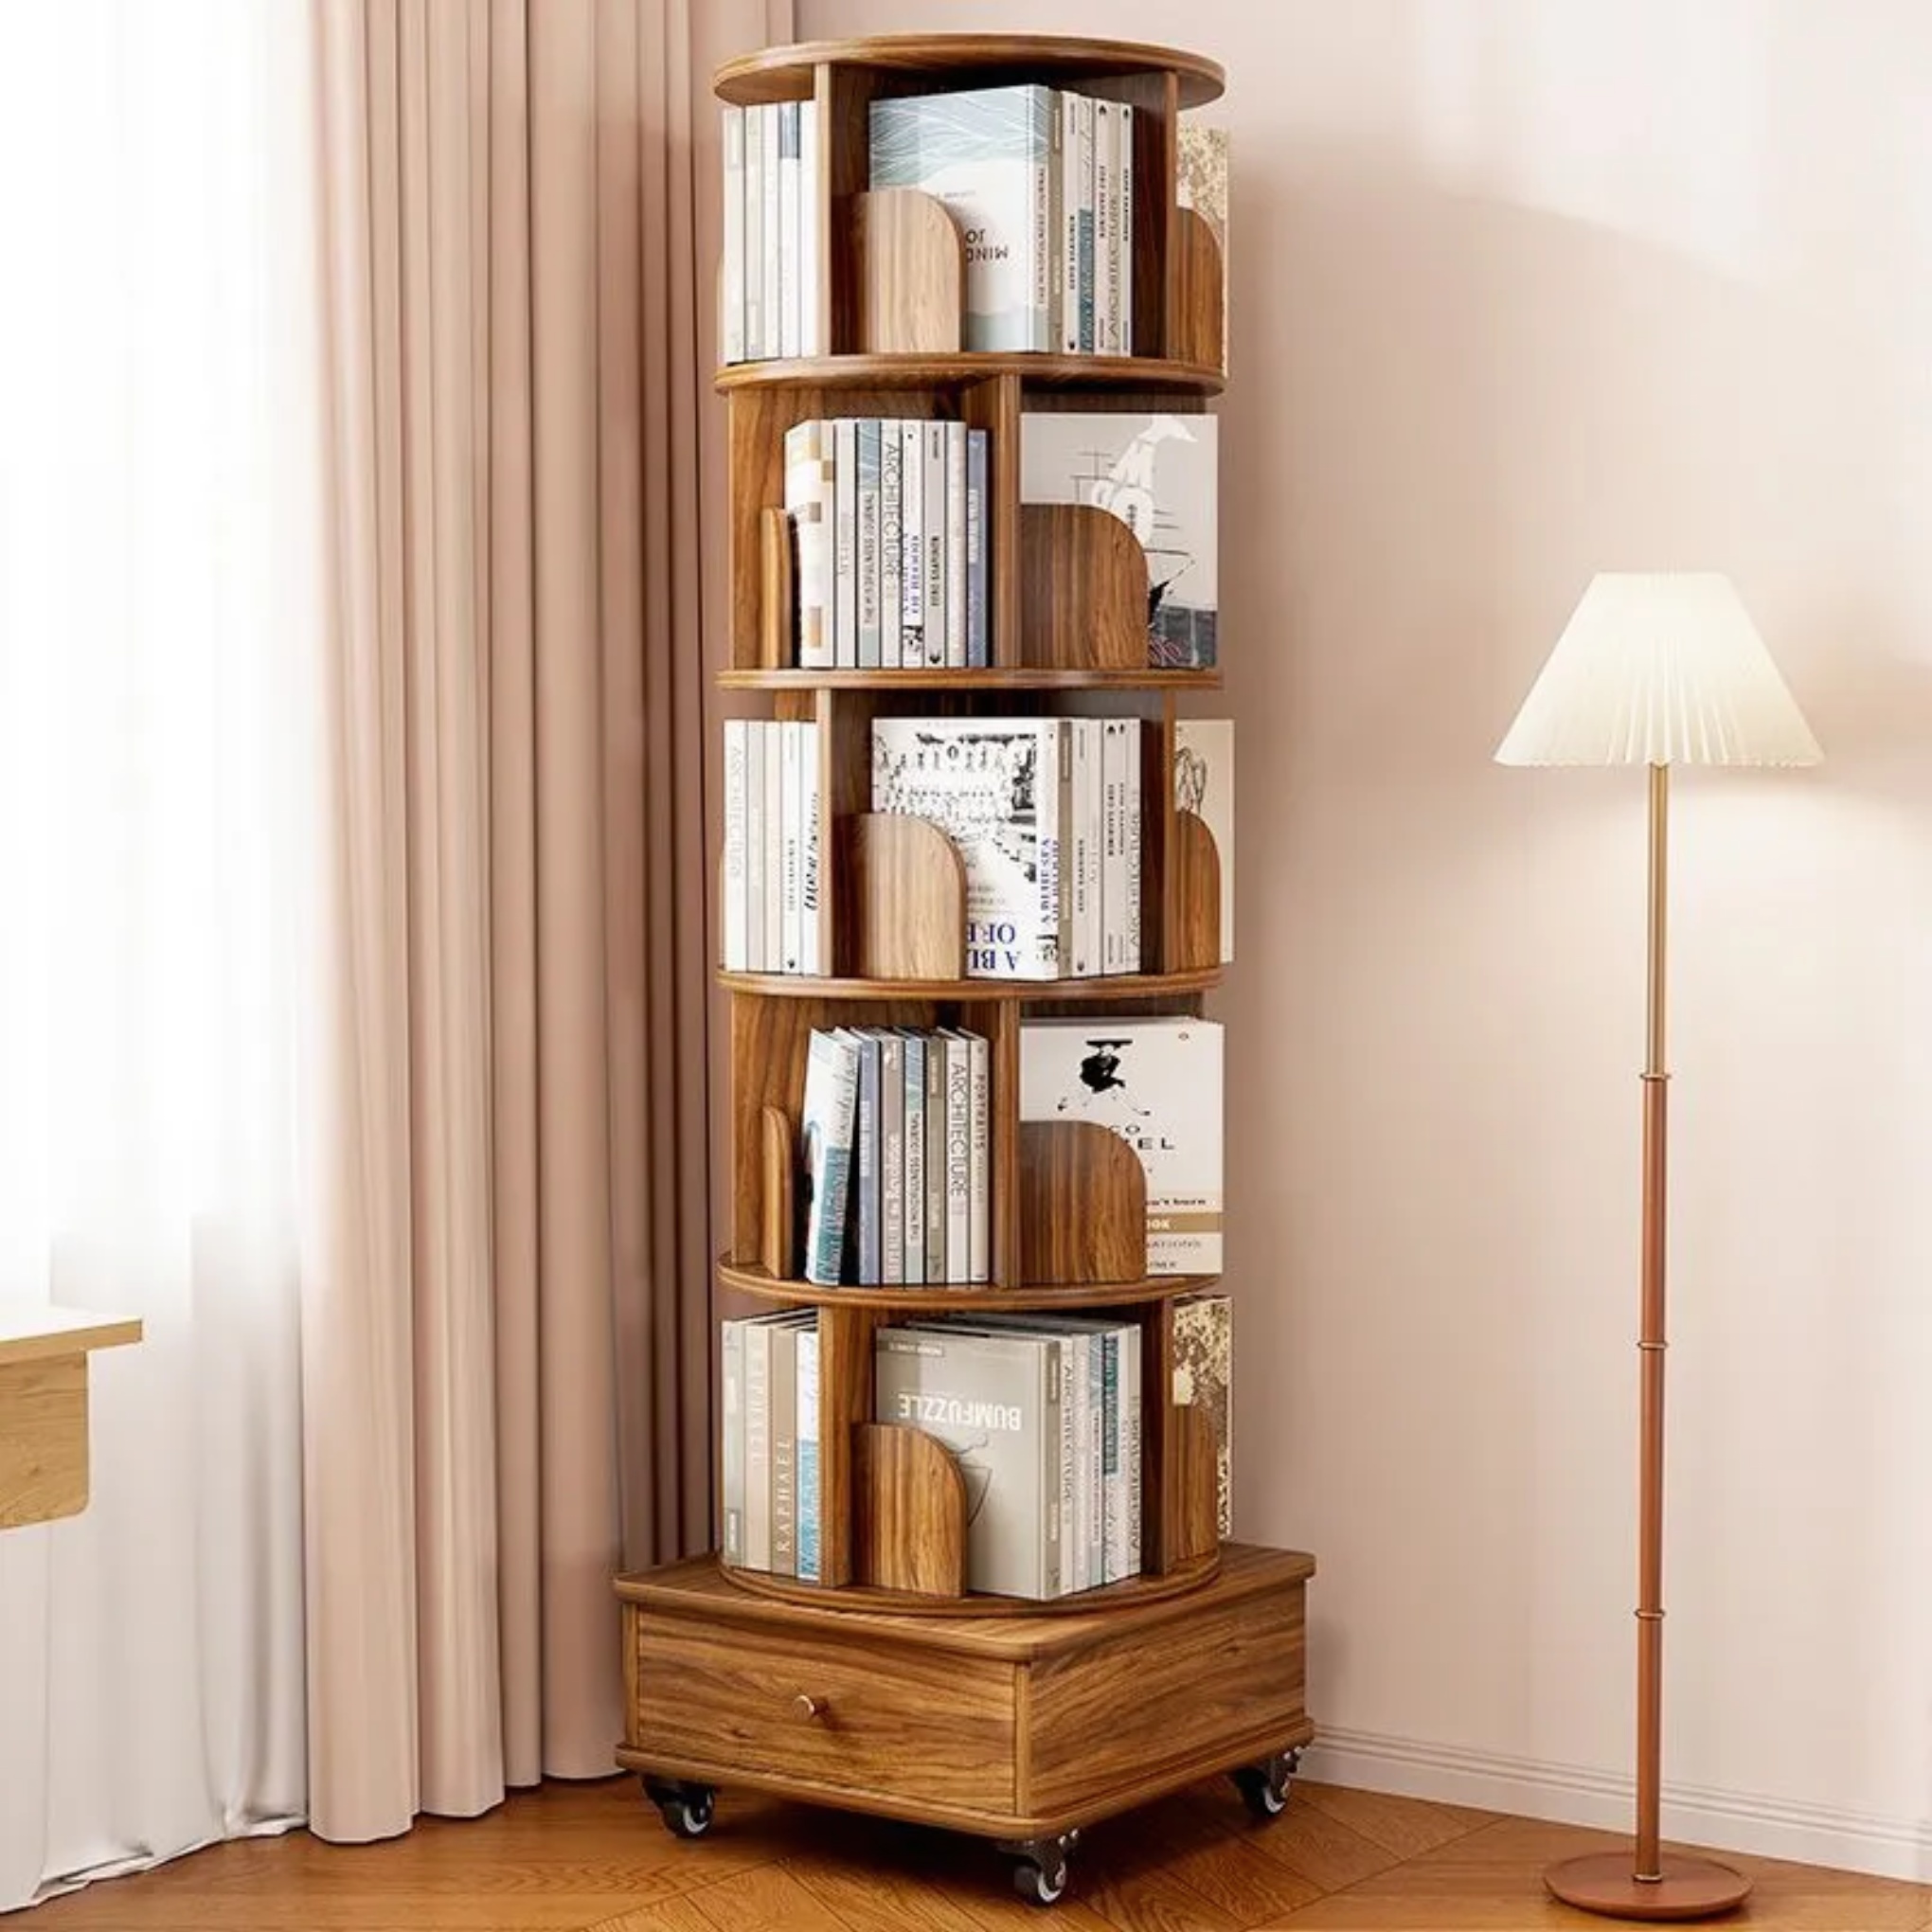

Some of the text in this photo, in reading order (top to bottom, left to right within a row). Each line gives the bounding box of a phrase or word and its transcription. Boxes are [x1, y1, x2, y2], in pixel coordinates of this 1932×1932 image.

[883, 442, 901, 577] ARCHITECTURE
[1004, 950, 1021, 971] A
[950, 1062, 967, 1196] ARCHITECTURE
[898, 1392, 1023, 1432] BUMFUZZLE
[777, 1437, 791, 1553] RAPHAEL
